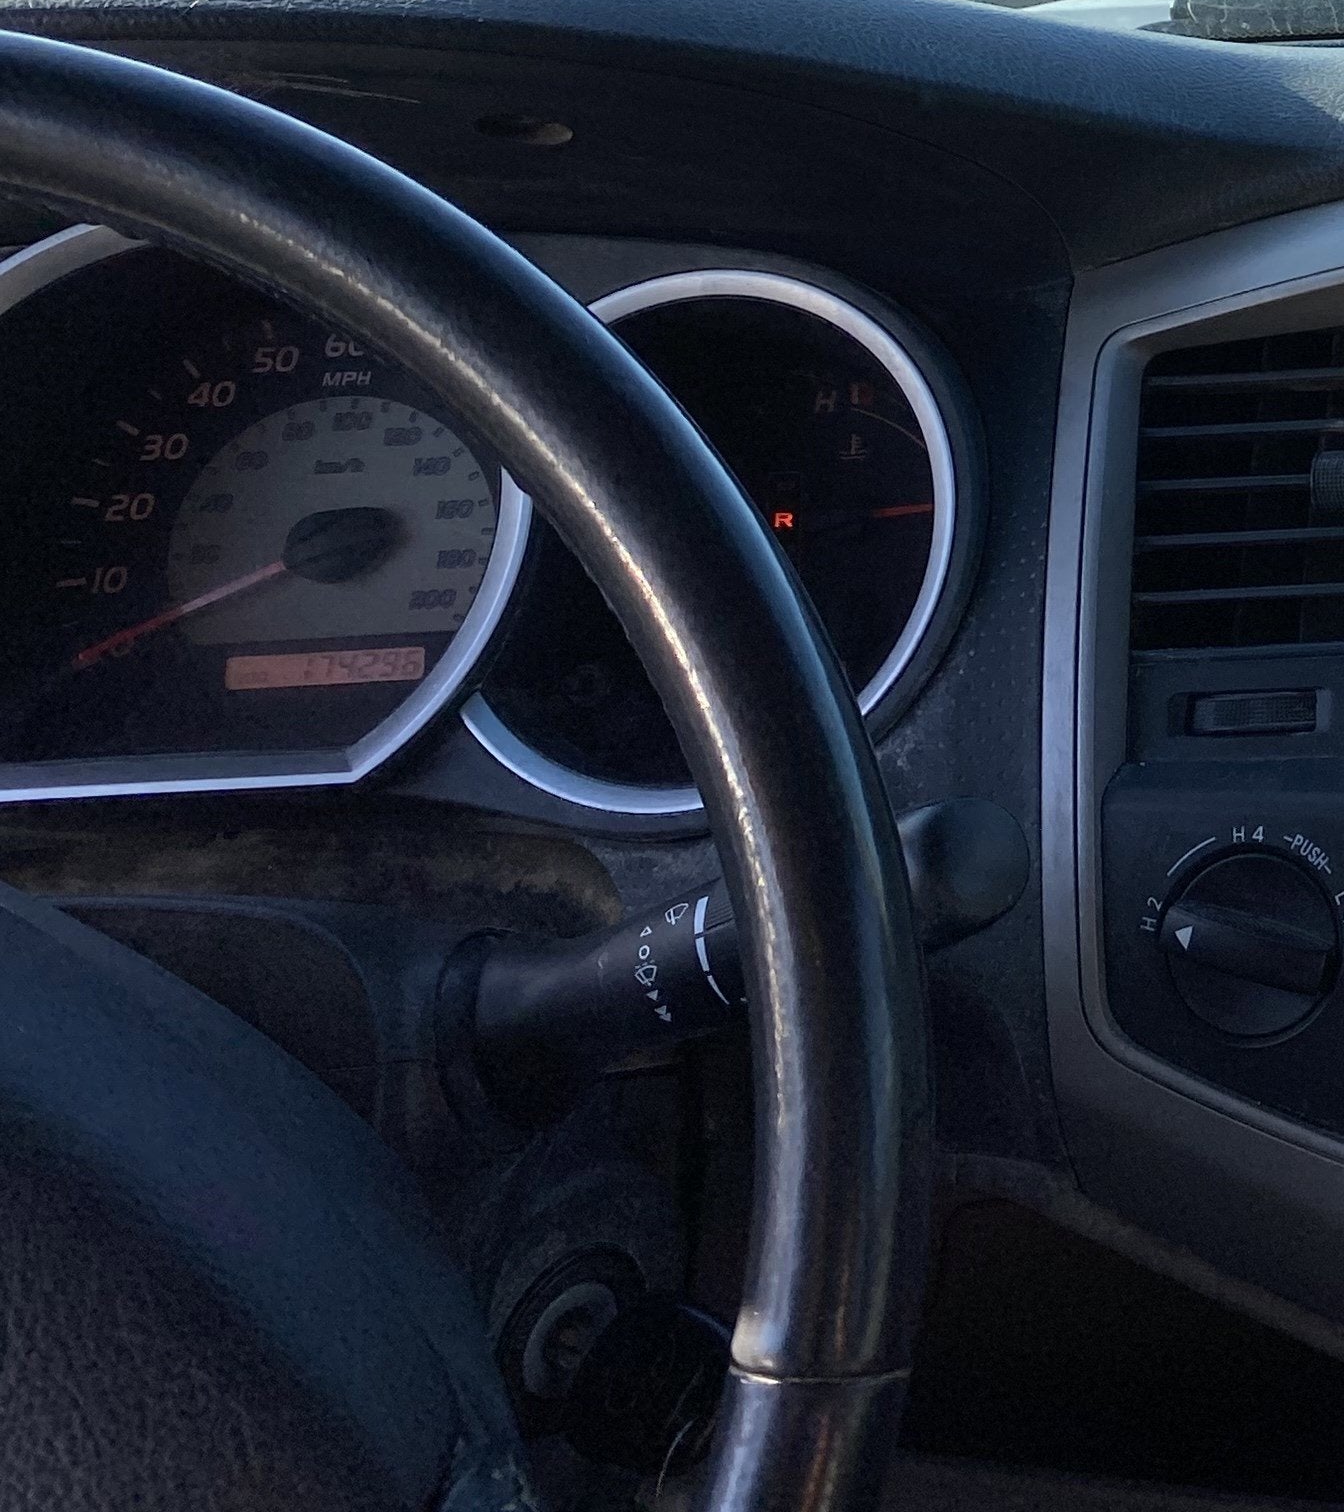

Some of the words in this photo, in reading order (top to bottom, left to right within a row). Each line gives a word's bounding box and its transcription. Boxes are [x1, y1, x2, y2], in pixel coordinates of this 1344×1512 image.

[253, 345, 300, 374] 50
[321, 371, 372, 387] MPH
[187, 380, 237, 408] 40
[139, 433, 190, 462] 30
[104, 493, 155, 522] 20
[774, 510, 794, 529] R
[92, 566, 128, 594] 10
